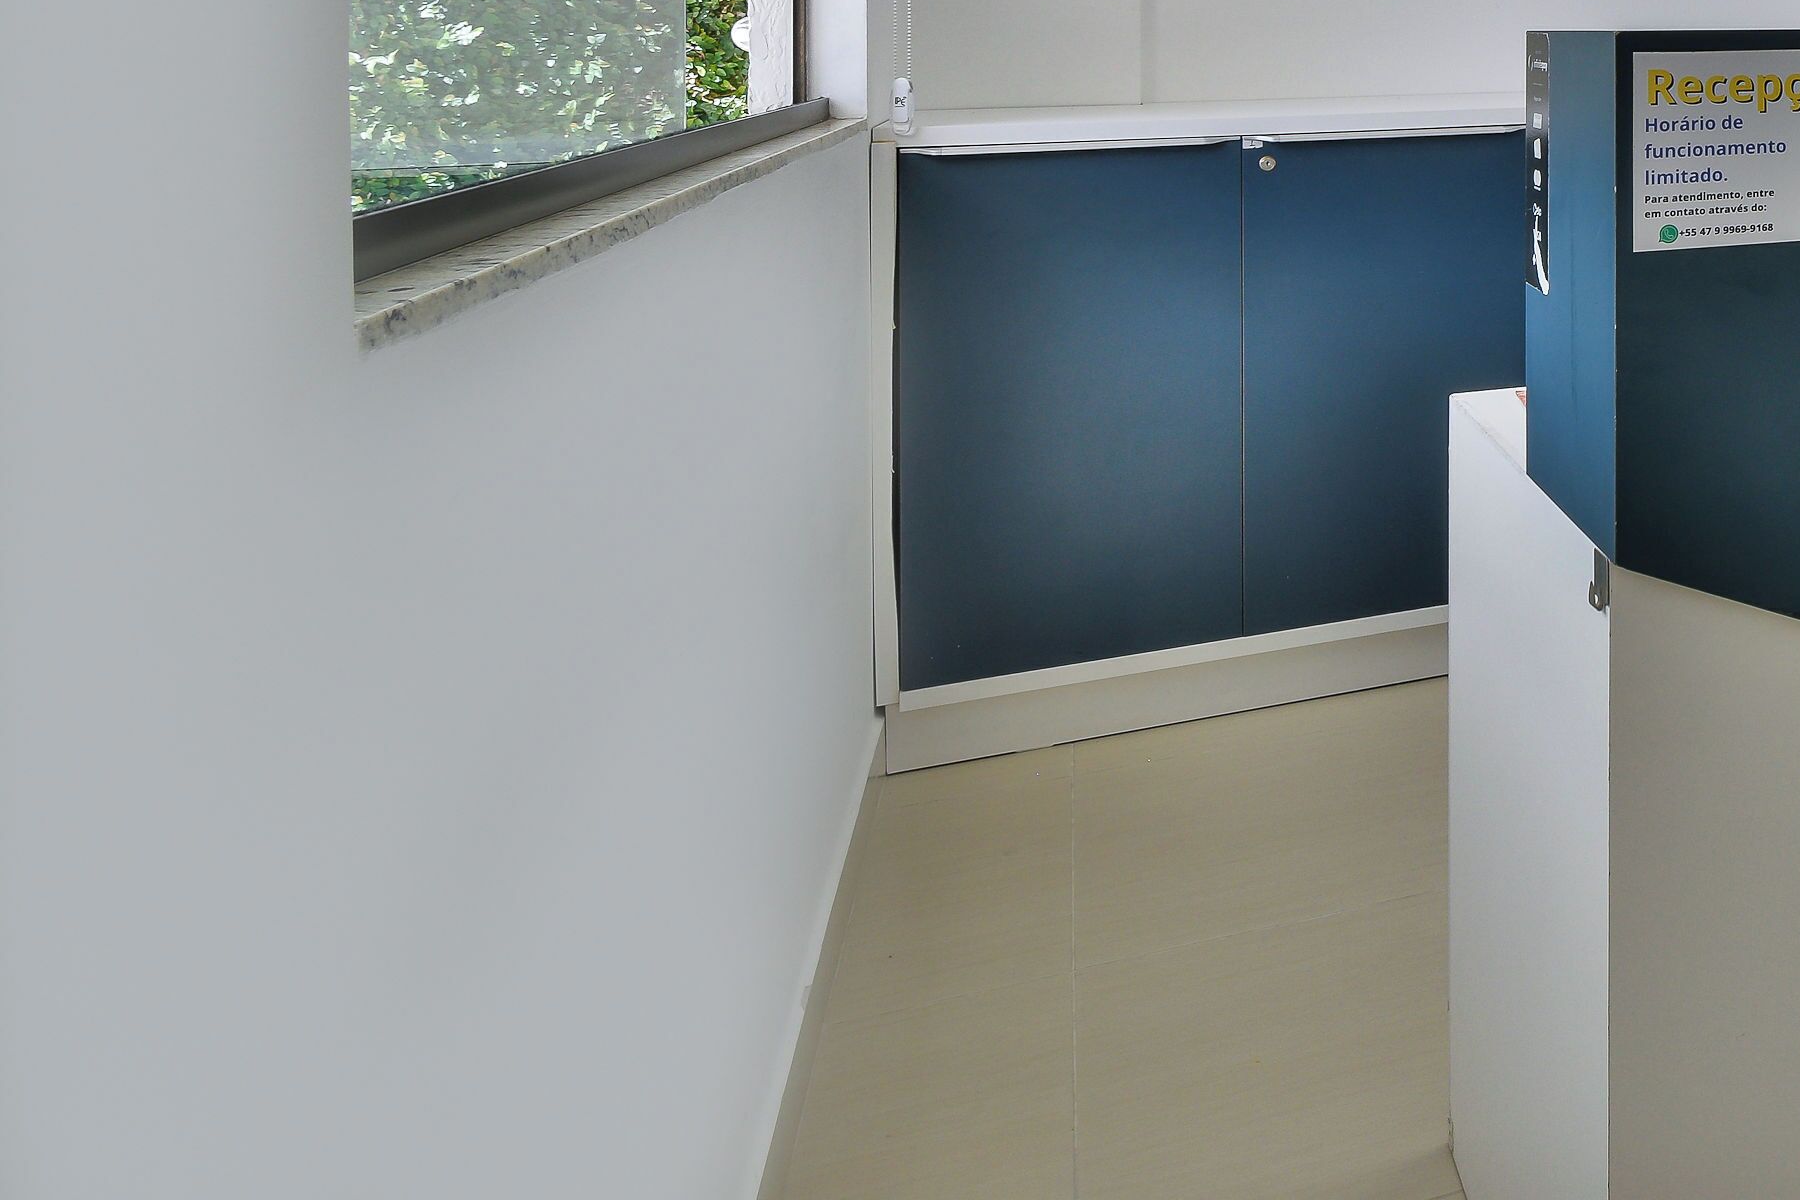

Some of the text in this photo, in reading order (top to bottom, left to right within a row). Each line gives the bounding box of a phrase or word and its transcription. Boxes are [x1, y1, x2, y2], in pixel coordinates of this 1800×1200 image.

[1645, 115, 1743, 132] Horário de
[1645, 140, 1786, 158] funcionamento
[1645, 168, 1728, 185] limitado.
[1645, 189, 1775, 204] Para atendimento, entre
[1644, 203, 1767, 219] em contato através do:
[1679, 223, 1774, 237] +55 47 9 9969-9168
